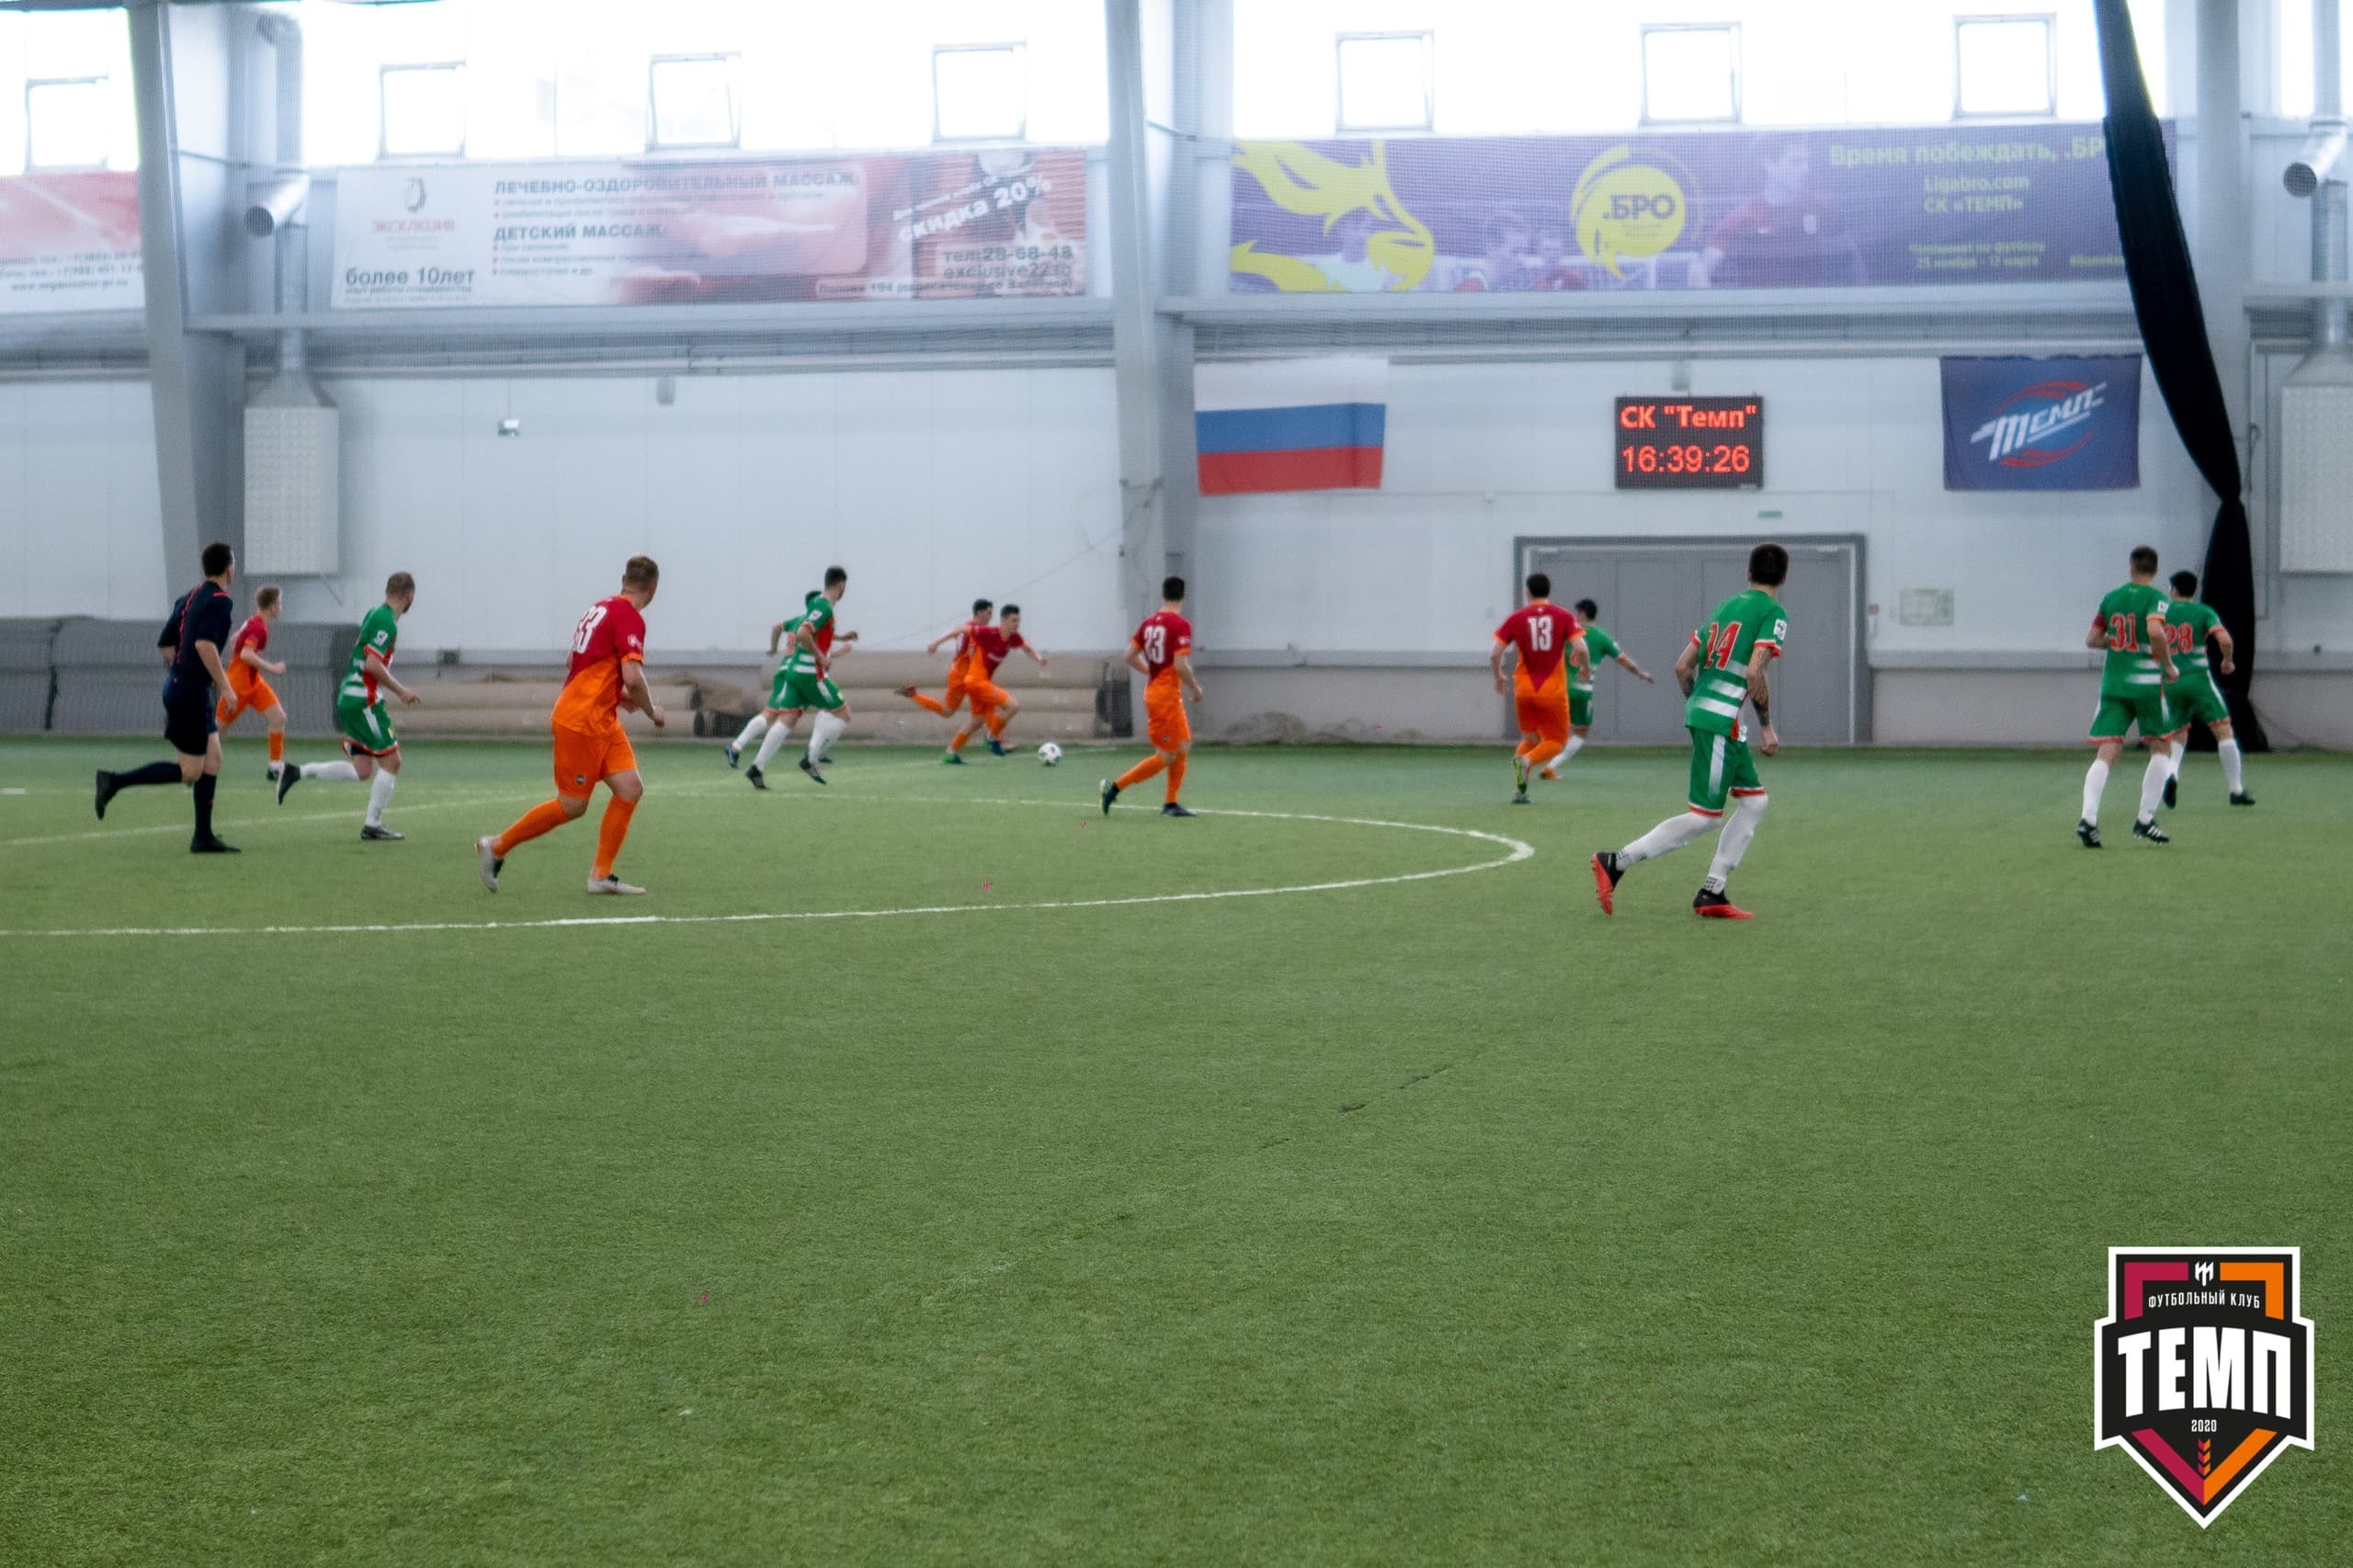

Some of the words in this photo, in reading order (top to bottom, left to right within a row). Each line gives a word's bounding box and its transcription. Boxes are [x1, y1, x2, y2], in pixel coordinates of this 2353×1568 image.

[1830, 145, 1907, 168] Время
[2065, 136, 2105, 160] .БР
[993, 173, 1052, 210] 20%
[1602, 193, 1677, 221] .БРО
[494, 222, 577, 242] ДЕТСКИЙ
[346, 266, 409, 286] более
[417, 266, 476, 286] 10лет
[1620, 404, 1655, 429] СК
[1663, 404, 1757, 429] "Темп"
[1622, 444, 1750, 473] 16:39:26
[1143, 625, 1166, 664] 23
[1528, 615, 1552, 652] 13
[1704, 621, 1742, 671] 14
[2109, 612, 2139, 653] 31
